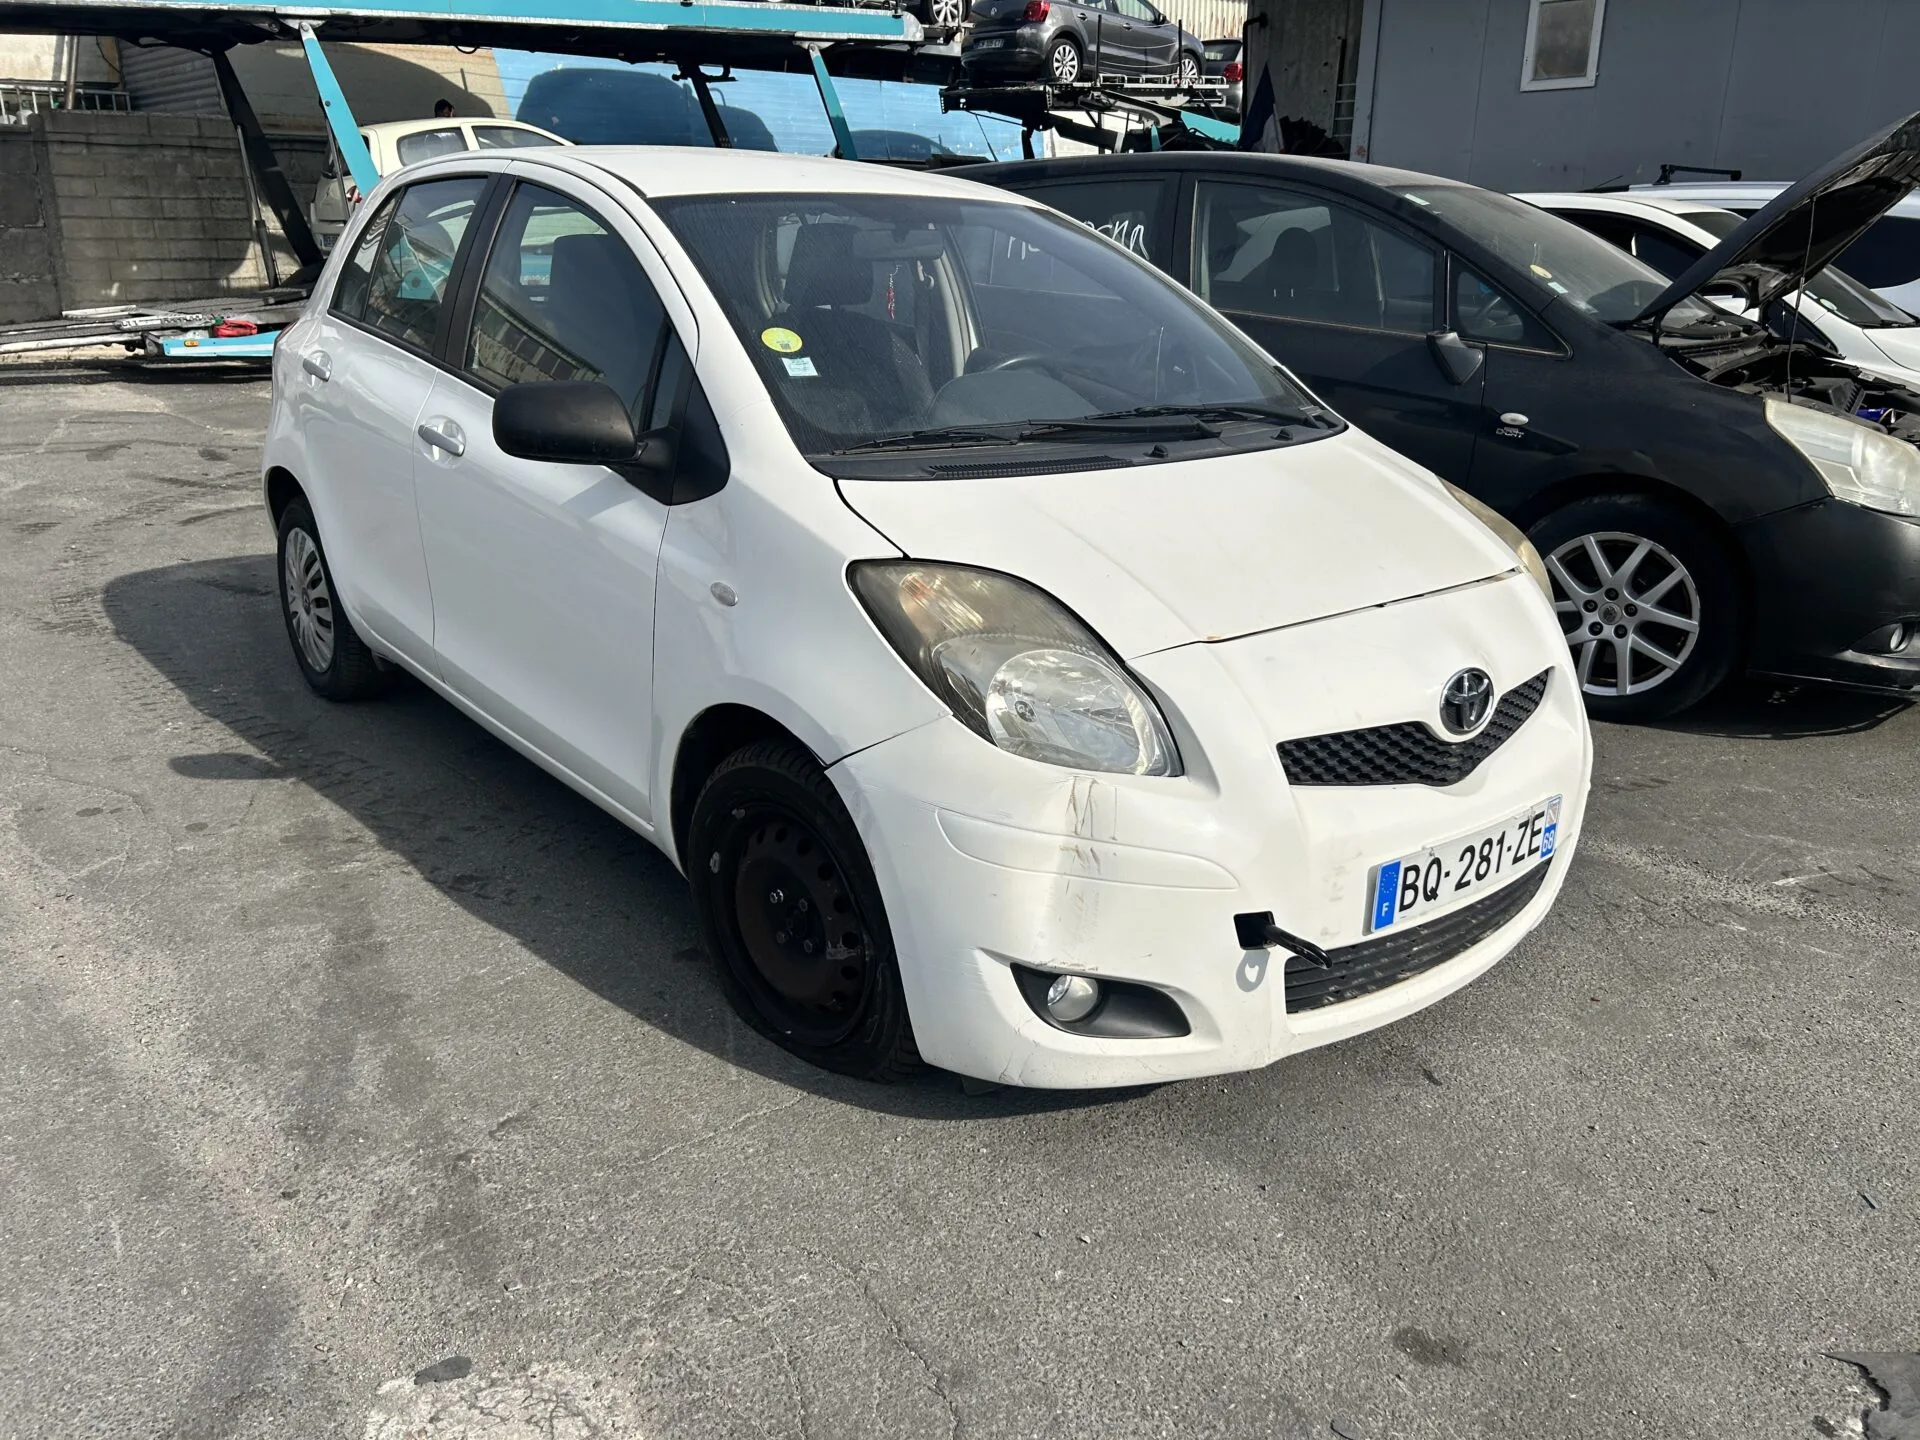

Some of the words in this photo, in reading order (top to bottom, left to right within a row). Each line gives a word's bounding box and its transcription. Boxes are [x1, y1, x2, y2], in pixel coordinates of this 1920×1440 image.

[1381, 902, 1389, 917] F
[1398, 811, 1545, 912] BQ-281-ZE
[1542, 829, 1555, 853] 68
